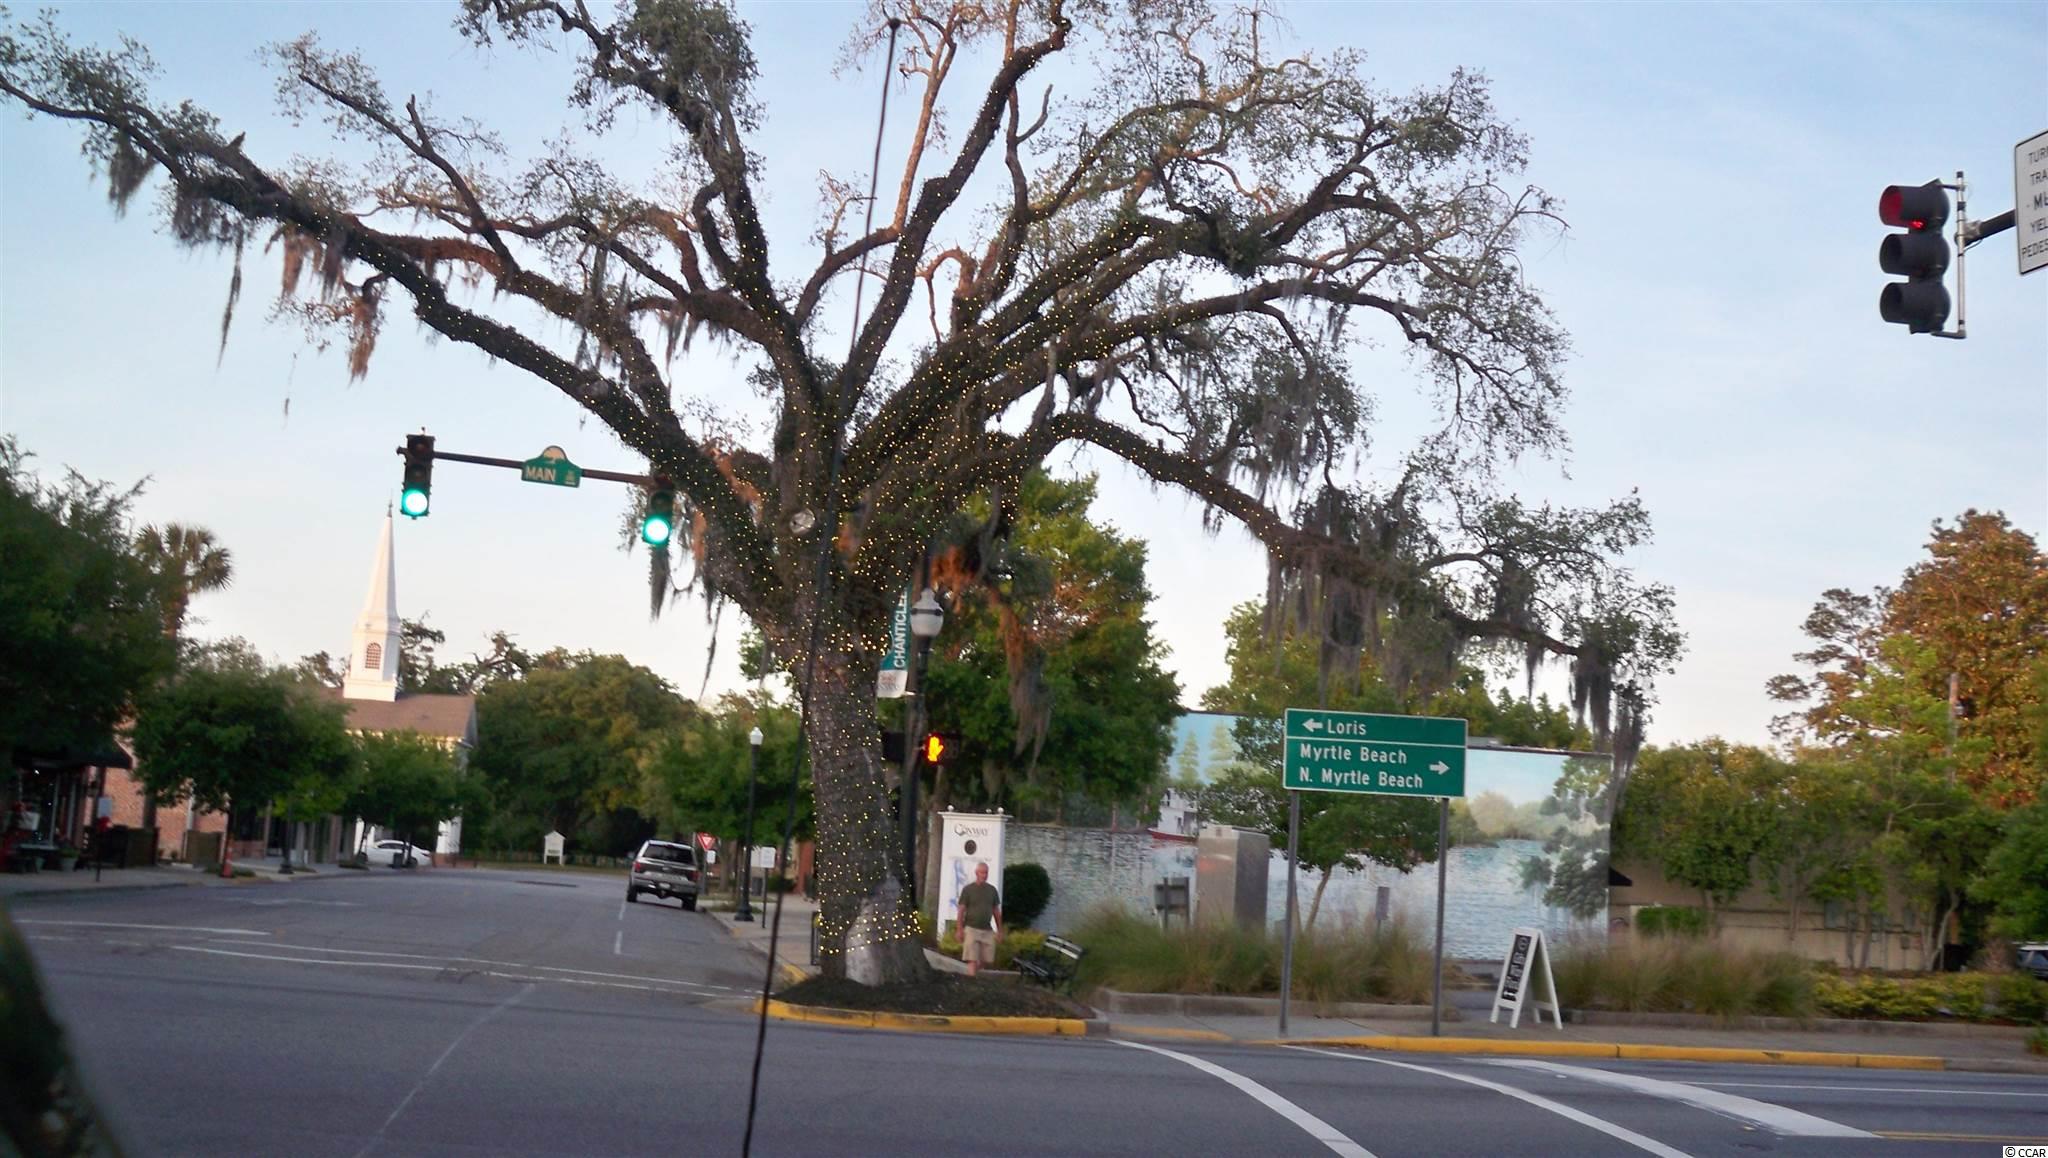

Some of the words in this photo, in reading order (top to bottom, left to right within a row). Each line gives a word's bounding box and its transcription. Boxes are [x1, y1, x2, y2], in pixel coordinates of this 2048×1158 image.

[526, 465, 556, 482] MAIN
[1327, 719, 1367, 735] Loris
[1300, 743, 1352, 762] Myrtle
[1360, 746, 1407, 764] Beach
[1299, 766, 1313, 782] N.
[1321, 768, 1370, 786] Myrtle
[1378, 771, 1423, 788] Beach
